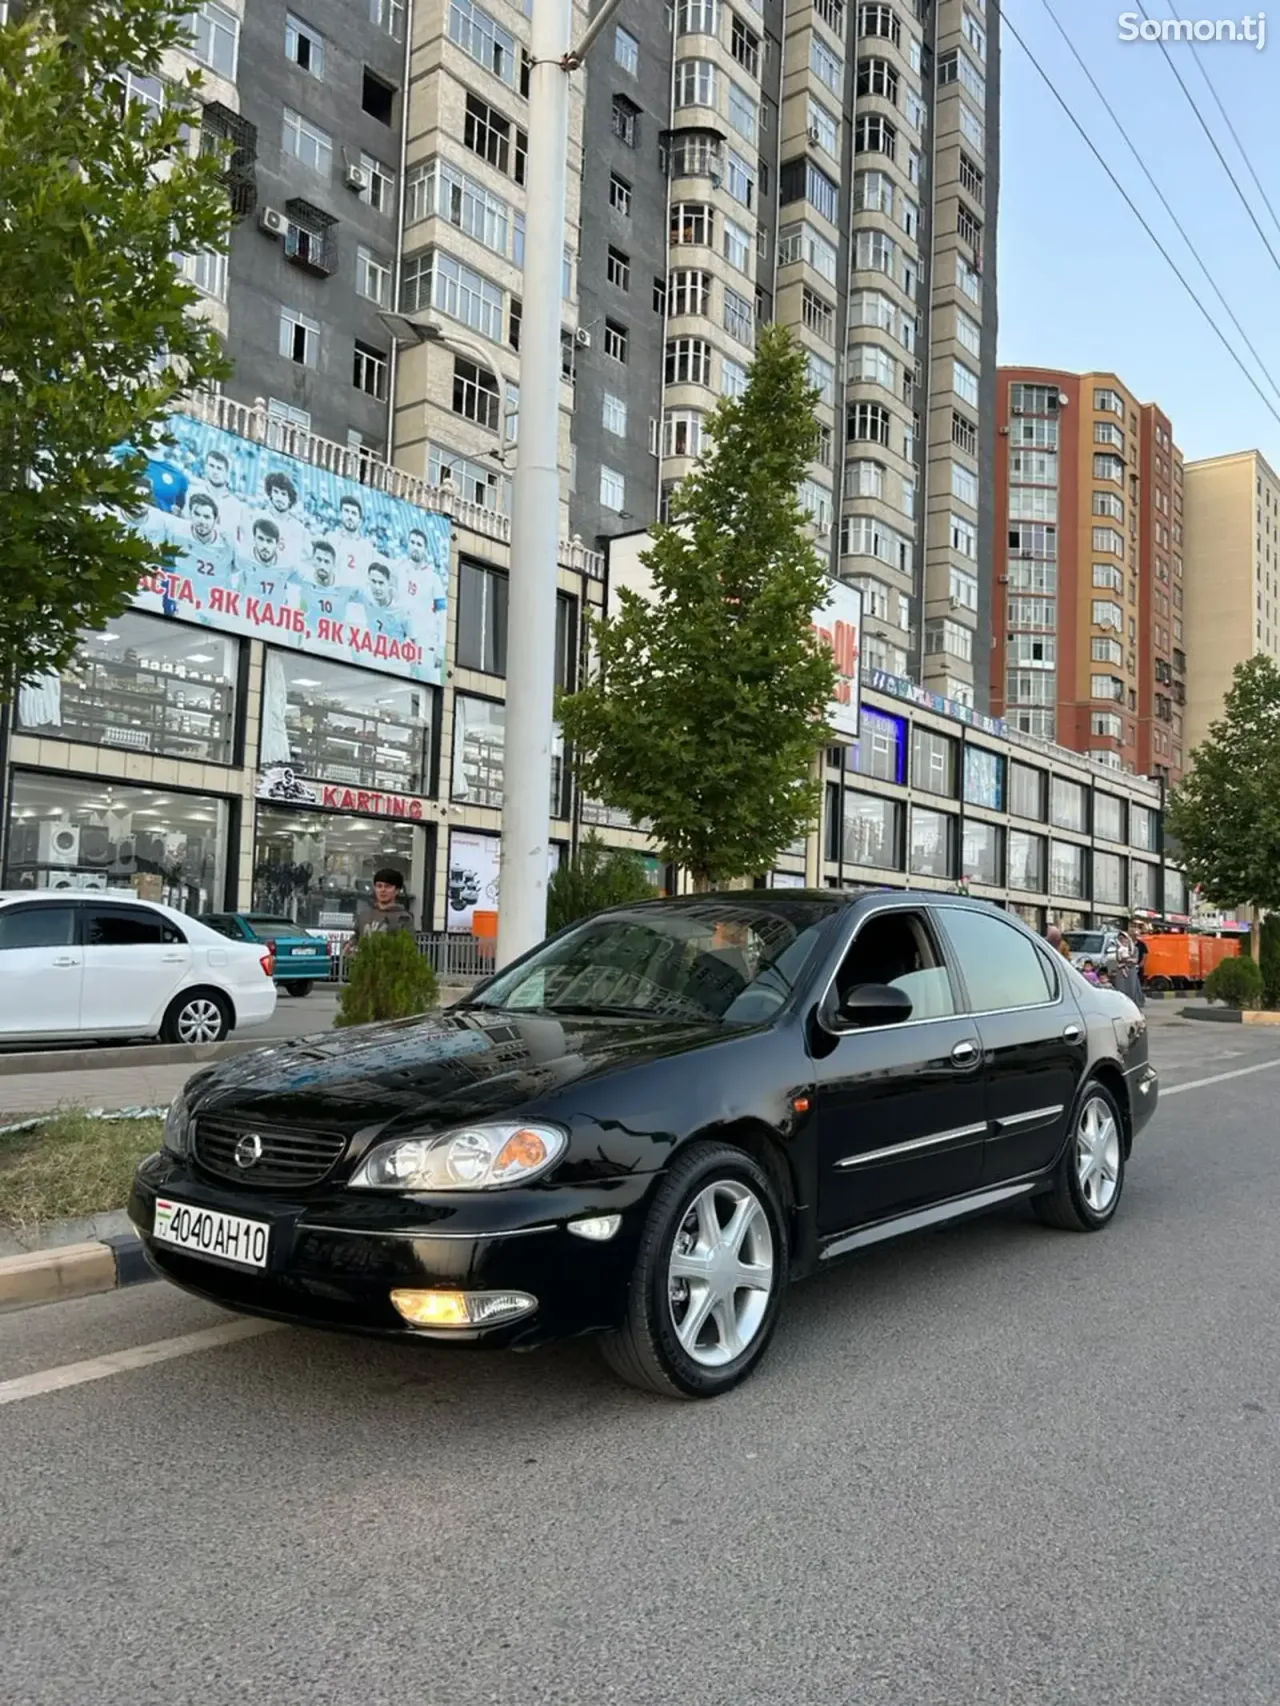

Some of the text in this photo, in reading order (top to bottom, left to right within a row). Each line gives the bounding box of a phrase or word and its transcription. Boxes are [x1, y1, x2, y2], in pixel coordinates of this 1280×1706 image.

[196, 559, 215, 577] 22
[260, 580, 275, 596] 17
[318, 599, 334, 614] 10
[208, 587, 240, 617] ЯК
[246, 596, 311, 640] ҚАЛБ,
[317, 618, 344, 645] ЯК
[348, 625, 424, 666] ҲАДАФ!
[322, 786, 423, 819] KARTING
